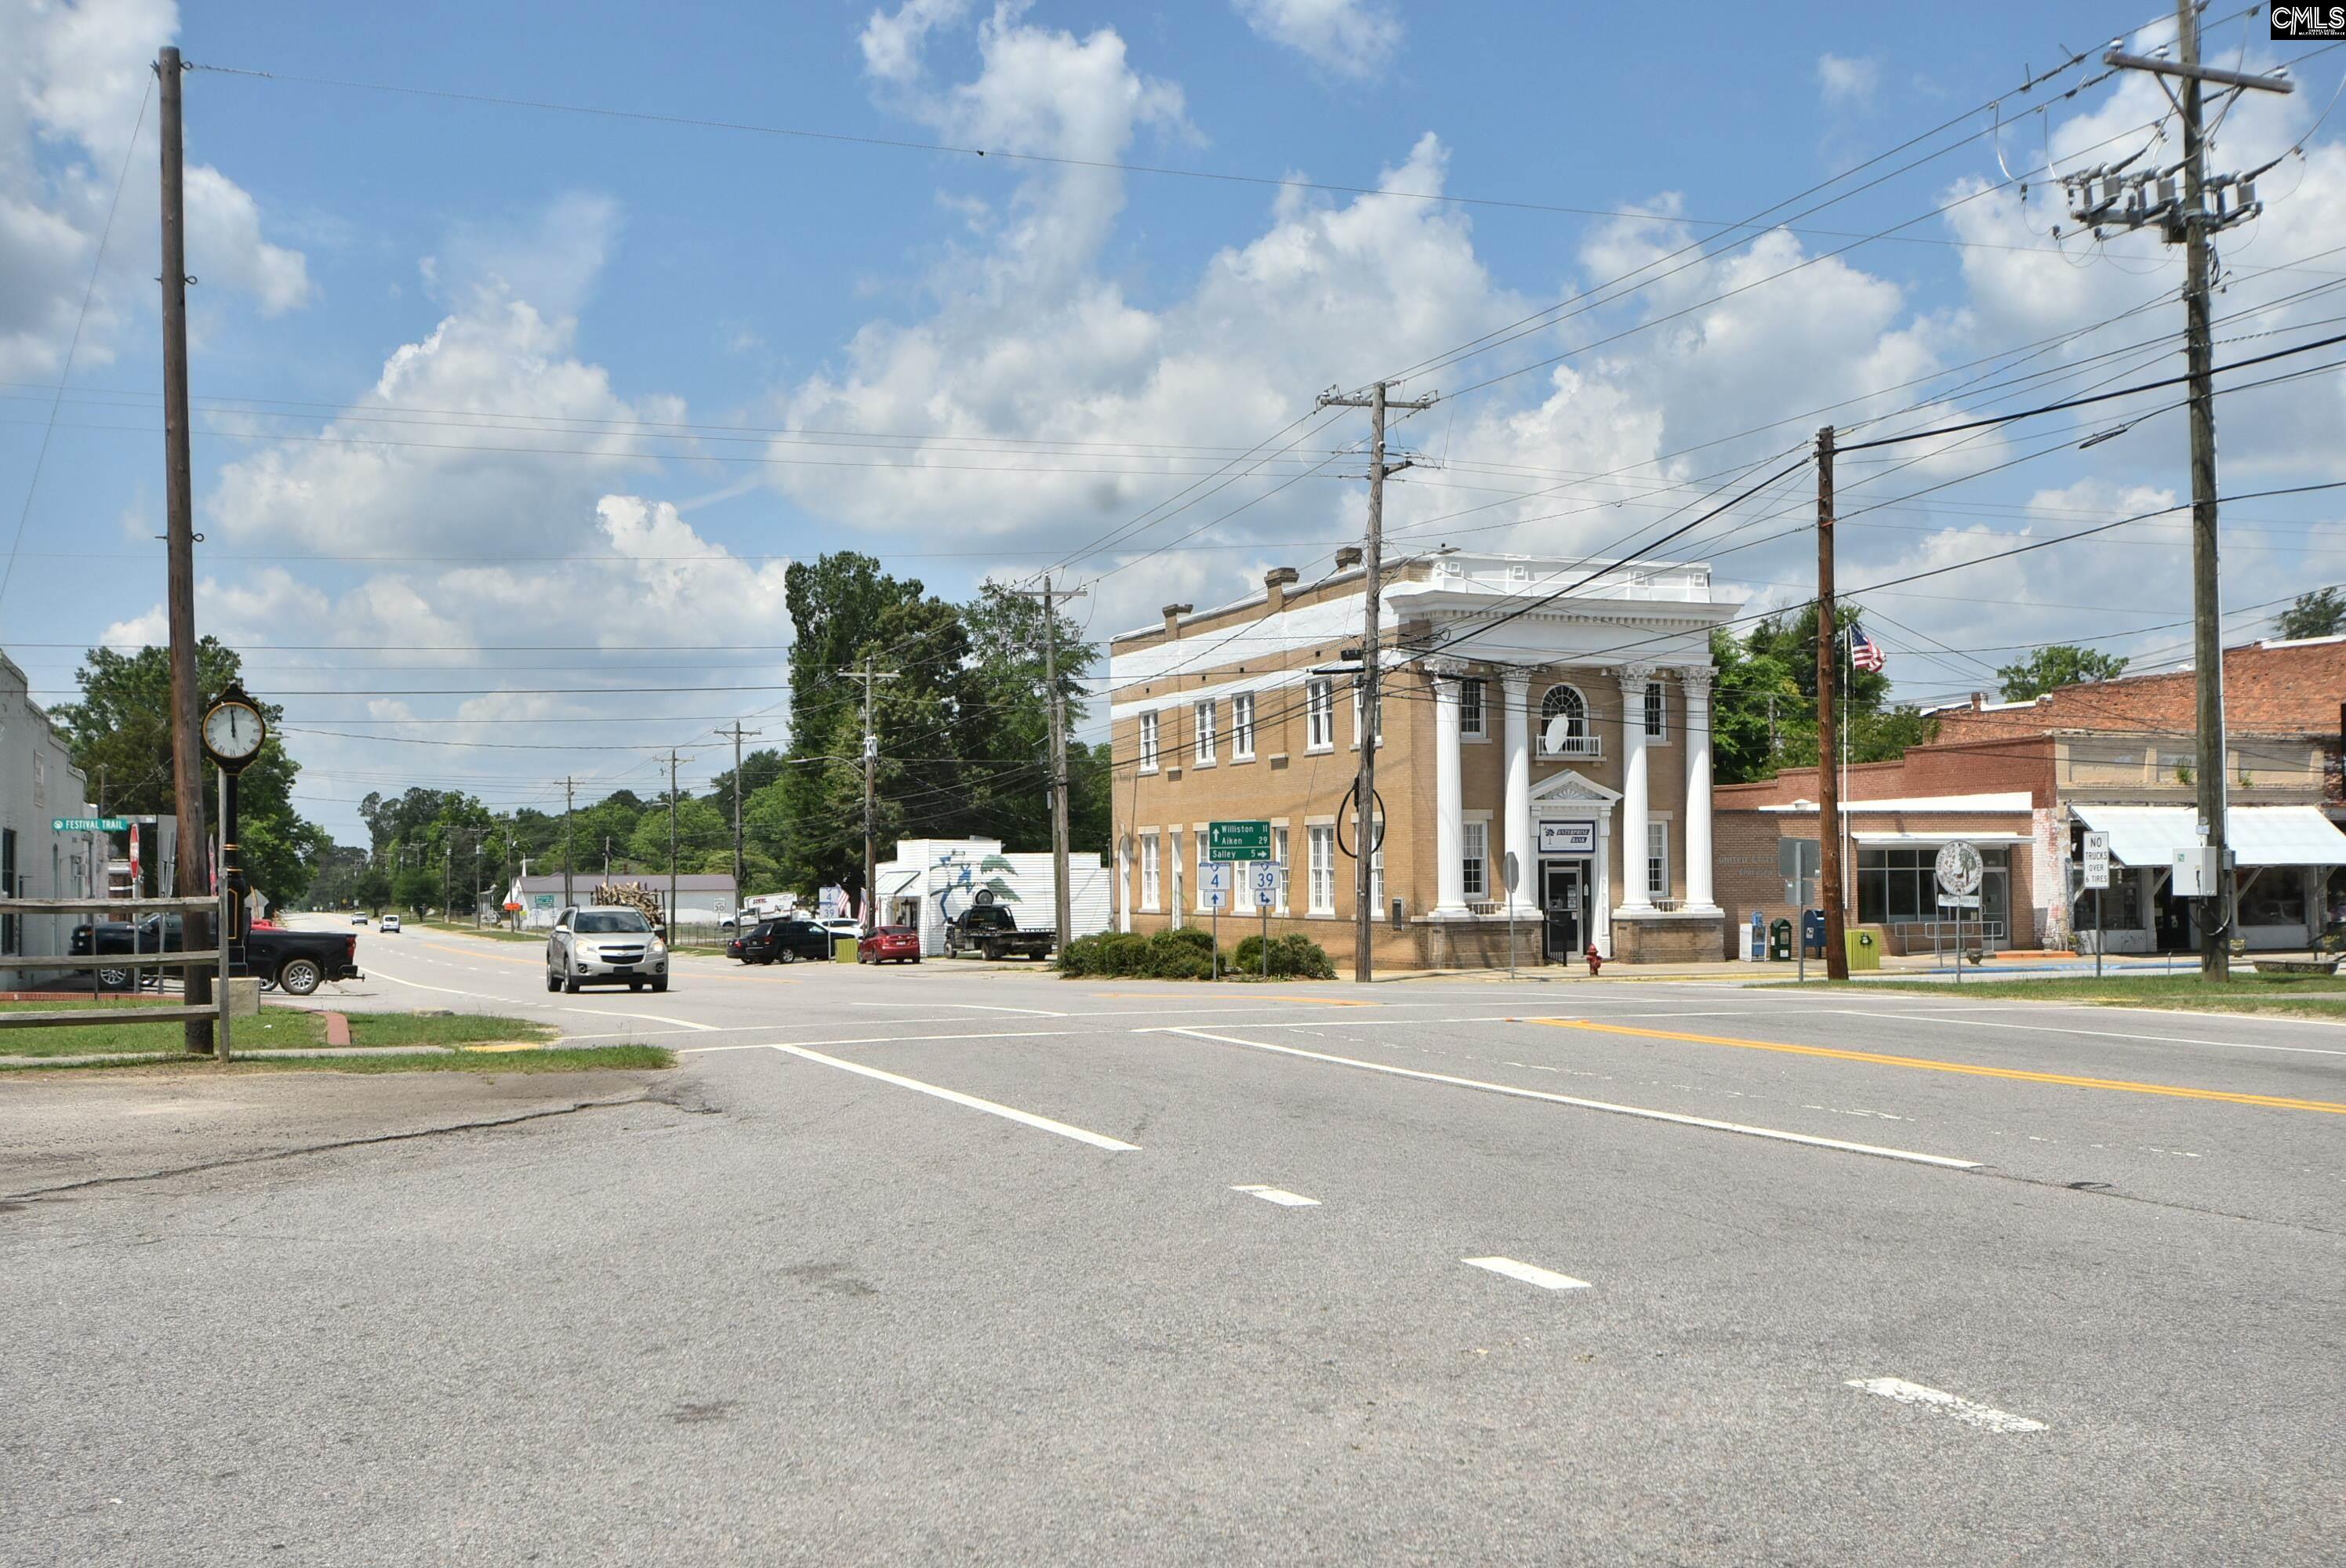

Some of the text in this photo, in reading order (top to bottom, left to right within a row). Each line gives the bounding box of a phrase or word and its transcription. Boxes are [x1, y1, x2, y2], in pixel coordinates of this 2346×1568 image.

[66, 820, 123, 829] FESTIVAL TRAIL
[1222, 825, 1254, 833] Williston
[2090, 837, 2102, 848] NO
[1212, 850, 1236, 859] Salley
[2086, 851, 2108, 860] TRUCKS
[1211, 873, 1218, 887] 4
[1258, 873, 1273, 887] 39
[824, 909, 834, 917] 39
